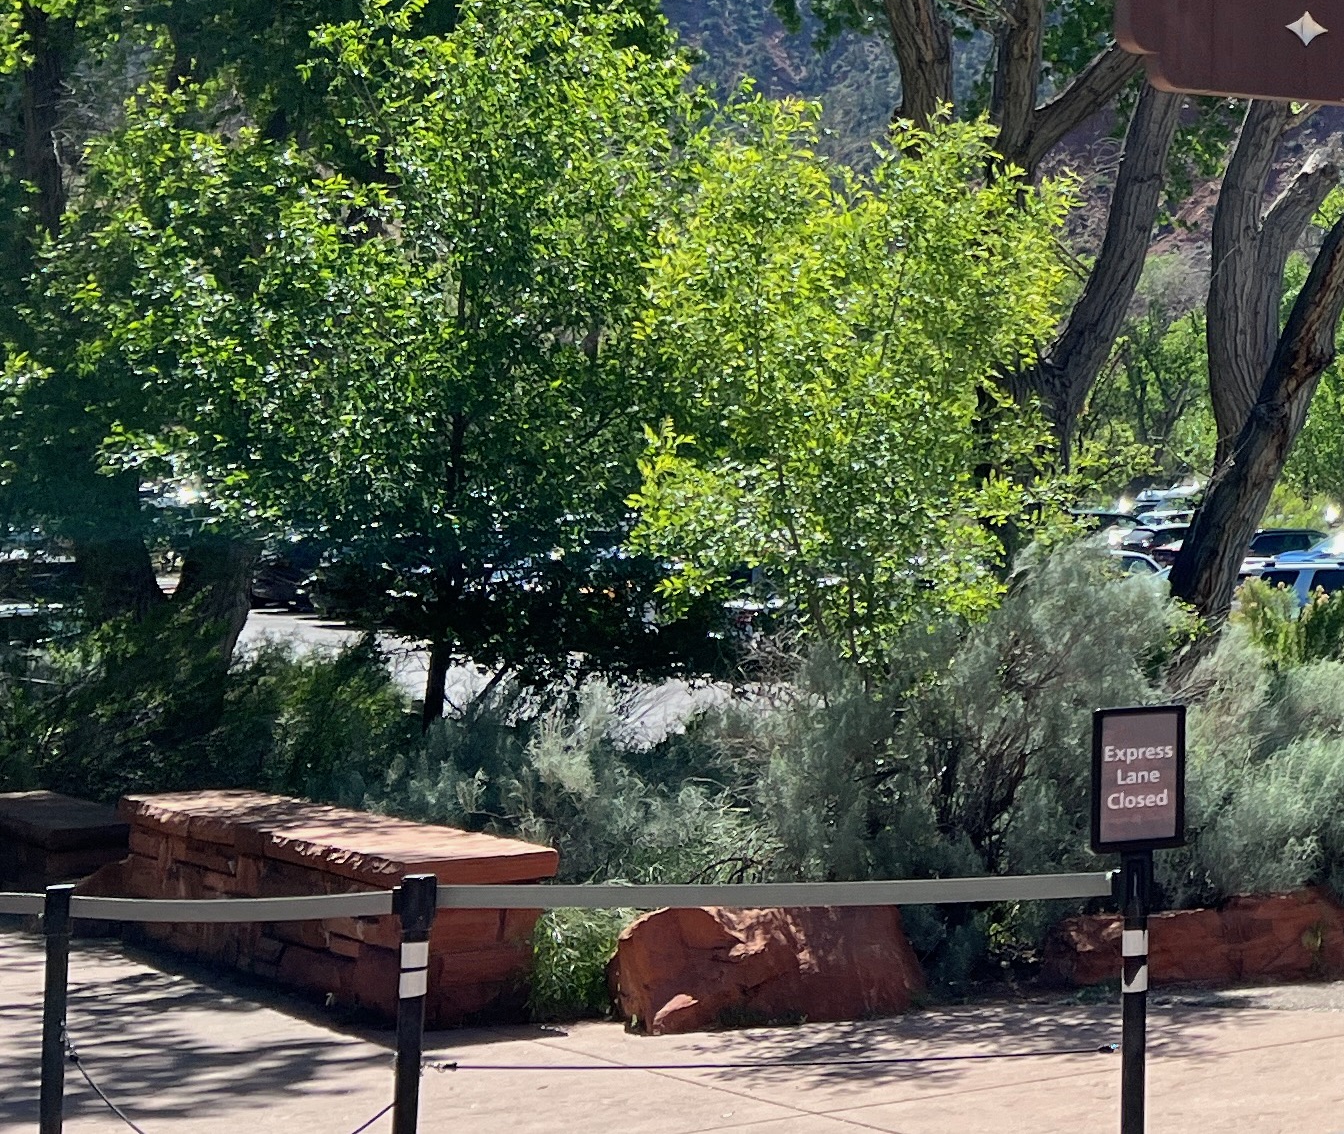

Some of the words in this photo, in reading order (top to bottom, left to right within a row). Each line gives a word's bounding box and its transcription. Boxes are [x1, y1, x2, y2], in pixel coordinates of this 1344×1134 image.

[1104, 745, 1173, 764] Express
[1117, 769, 1160, 784] Lane
[1107, 789, 1168, 809] Closed
